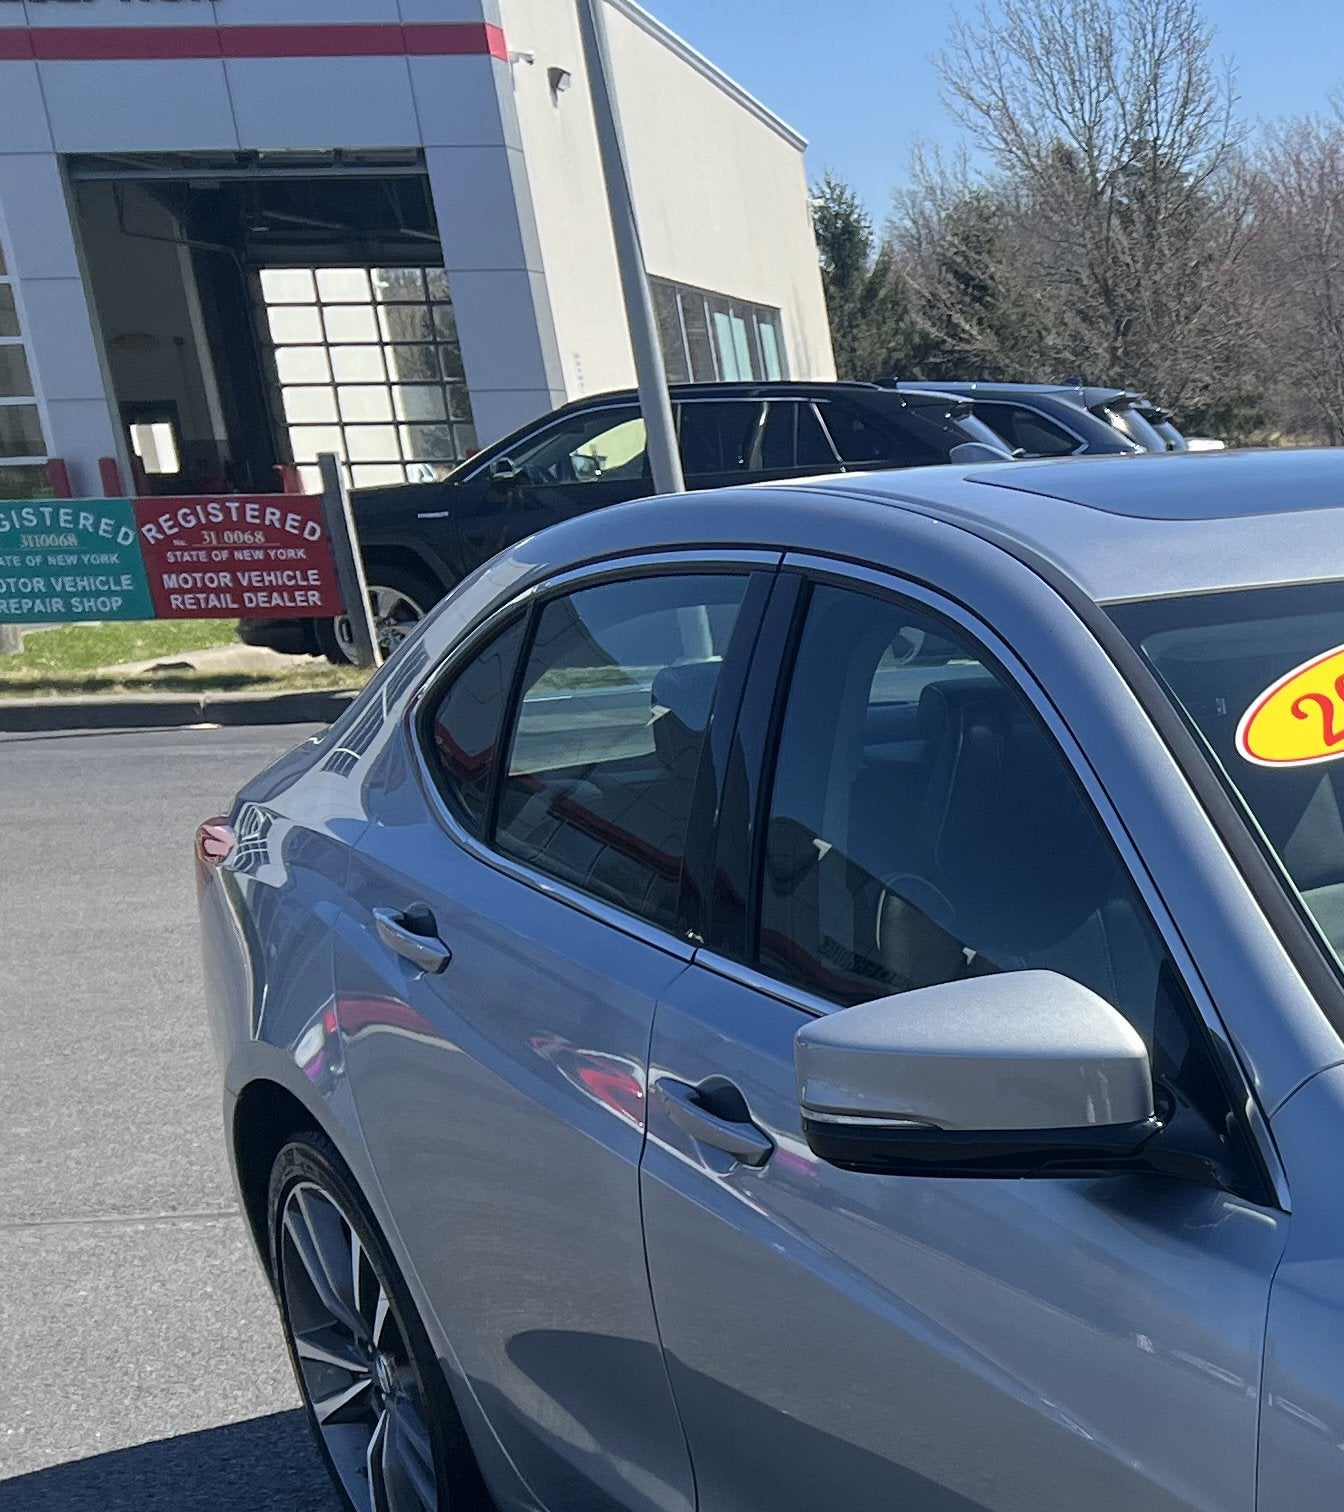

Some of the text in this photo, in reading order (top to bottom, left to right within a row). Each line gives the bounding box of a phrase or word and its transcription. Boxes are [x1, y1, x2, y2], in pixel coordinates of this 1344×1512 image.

[141, 502, 321, 544] REGISTERED
[25, 555, 42, 567] OF
[48, 554, 78, 566] NEW
[80, 553, 120, 565] YORK
[167, 548, 307, 563] STATE OF NEW YORK
[50, 575, 133, 592] VEHICLE
[162, 570, 322, 589] MOTOR VEHICLE
[70, 597, 122, 613] SHOP
[170, 591, 322, 610] RETAIL DEALER
